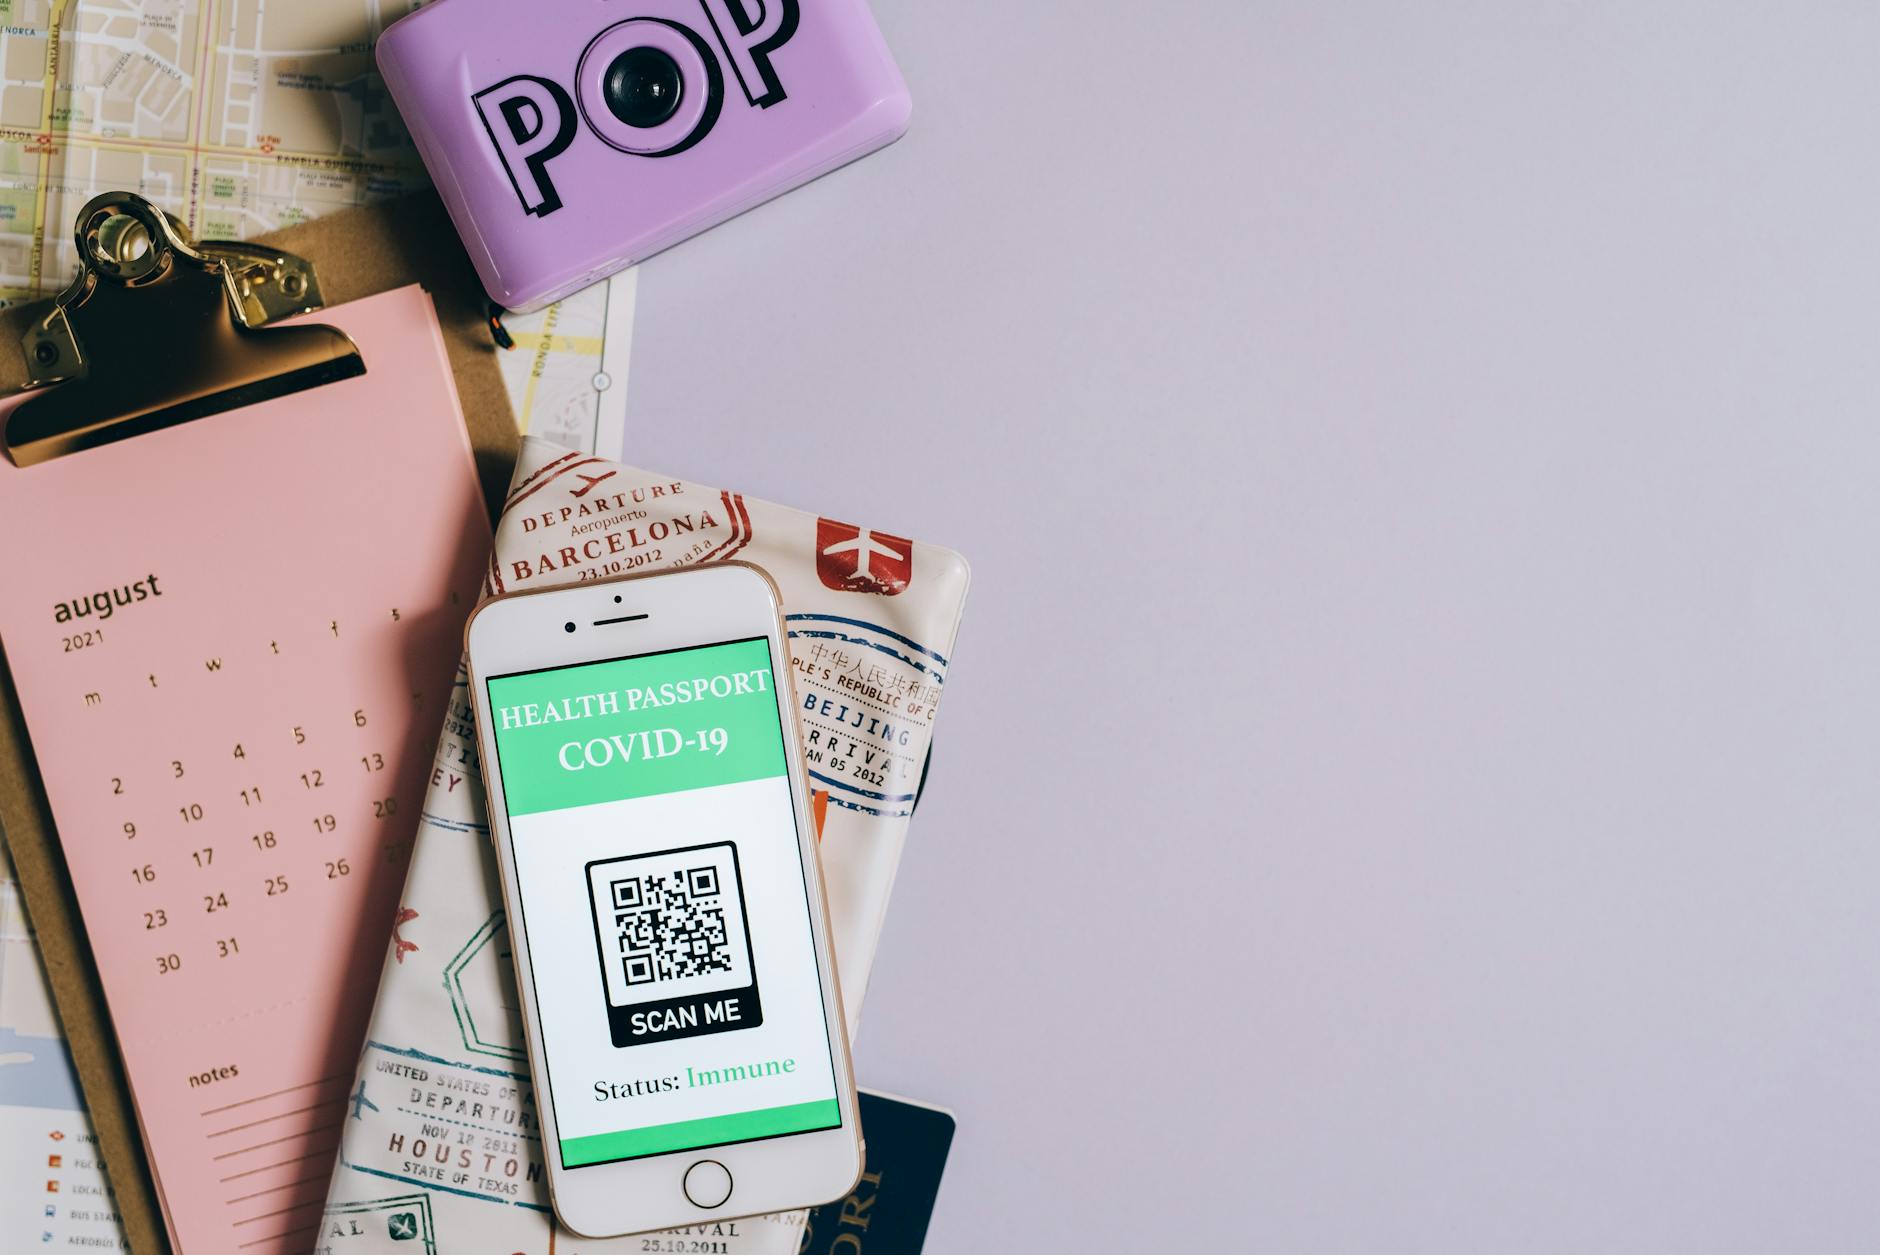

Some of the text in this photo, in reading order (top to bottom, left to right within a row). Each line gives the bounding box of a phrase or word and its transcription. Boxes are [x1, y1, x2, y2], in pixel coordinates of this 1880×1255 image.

[470, 0, 801, 218] POP
[521, 482, 685, 533] DEPARTURE
[570, 508, 647, 537] Aeropuerto
[511, 510, 719, 581] BARCELONA
[577, 549, 663, 582] 23.10.2012
[668, 537, 713, 570] paña
[53, 573, 162, 624] august
[61, 629, 104, 653] 2021
[84, 690, 102, 706] m
[149, 673, 158, 688] t
[206, 656, 222, 672] w
[270, 640, 279, 654] t
[330, 621, 339, 638] f
[499, 668, 771, 730] HEALTH PASSPORT
[837, 671, 899, 709] REPUBLIC
[906, 701, 921, 717] OF
[803, 691, 911, 748] BEIJING
[111, 778, 124, 795] 2
[172, 760, 185, 778] 3
[233, 744, 246, 760] 4
[293, 726, 306, 744] 5
[354, 709, 367, 728] 6
[558, 726, 729, 772] COVID-19
[802, 729, 908, 780] RRIVAL
[803, 745, 885, 788] AN 05 2012
[123, 753, 386, 840] 9 10 11 12 13
[132, 798, 397, 885] 16 17 18 19 20
[144, 909, 168, 930] 23
[204, 892, 230, 914] 24
[265, 875, 289, 896] 25
[325, 858, 351, 880] 26
[156, 937, 241, 974] 30 31
[630, 998, 742, 1036] SCAN ME
[189, 1064, 240, 1088] notes
[376, 1059, 429, 1082] UNITED
[436, 1073, 491, 1097] STATES
[498, 1085, 518, 1101] OF
[594, 1056, 796, 1102] Status: Immune
[421, 1123, 449, 1140] NOV
[388, 1132, 544, 1183] HOUSTON
[402, 1161, 519, 1196] STATE OF TEXAS
[641, 1239, 729, 1255] 25.10.2011
